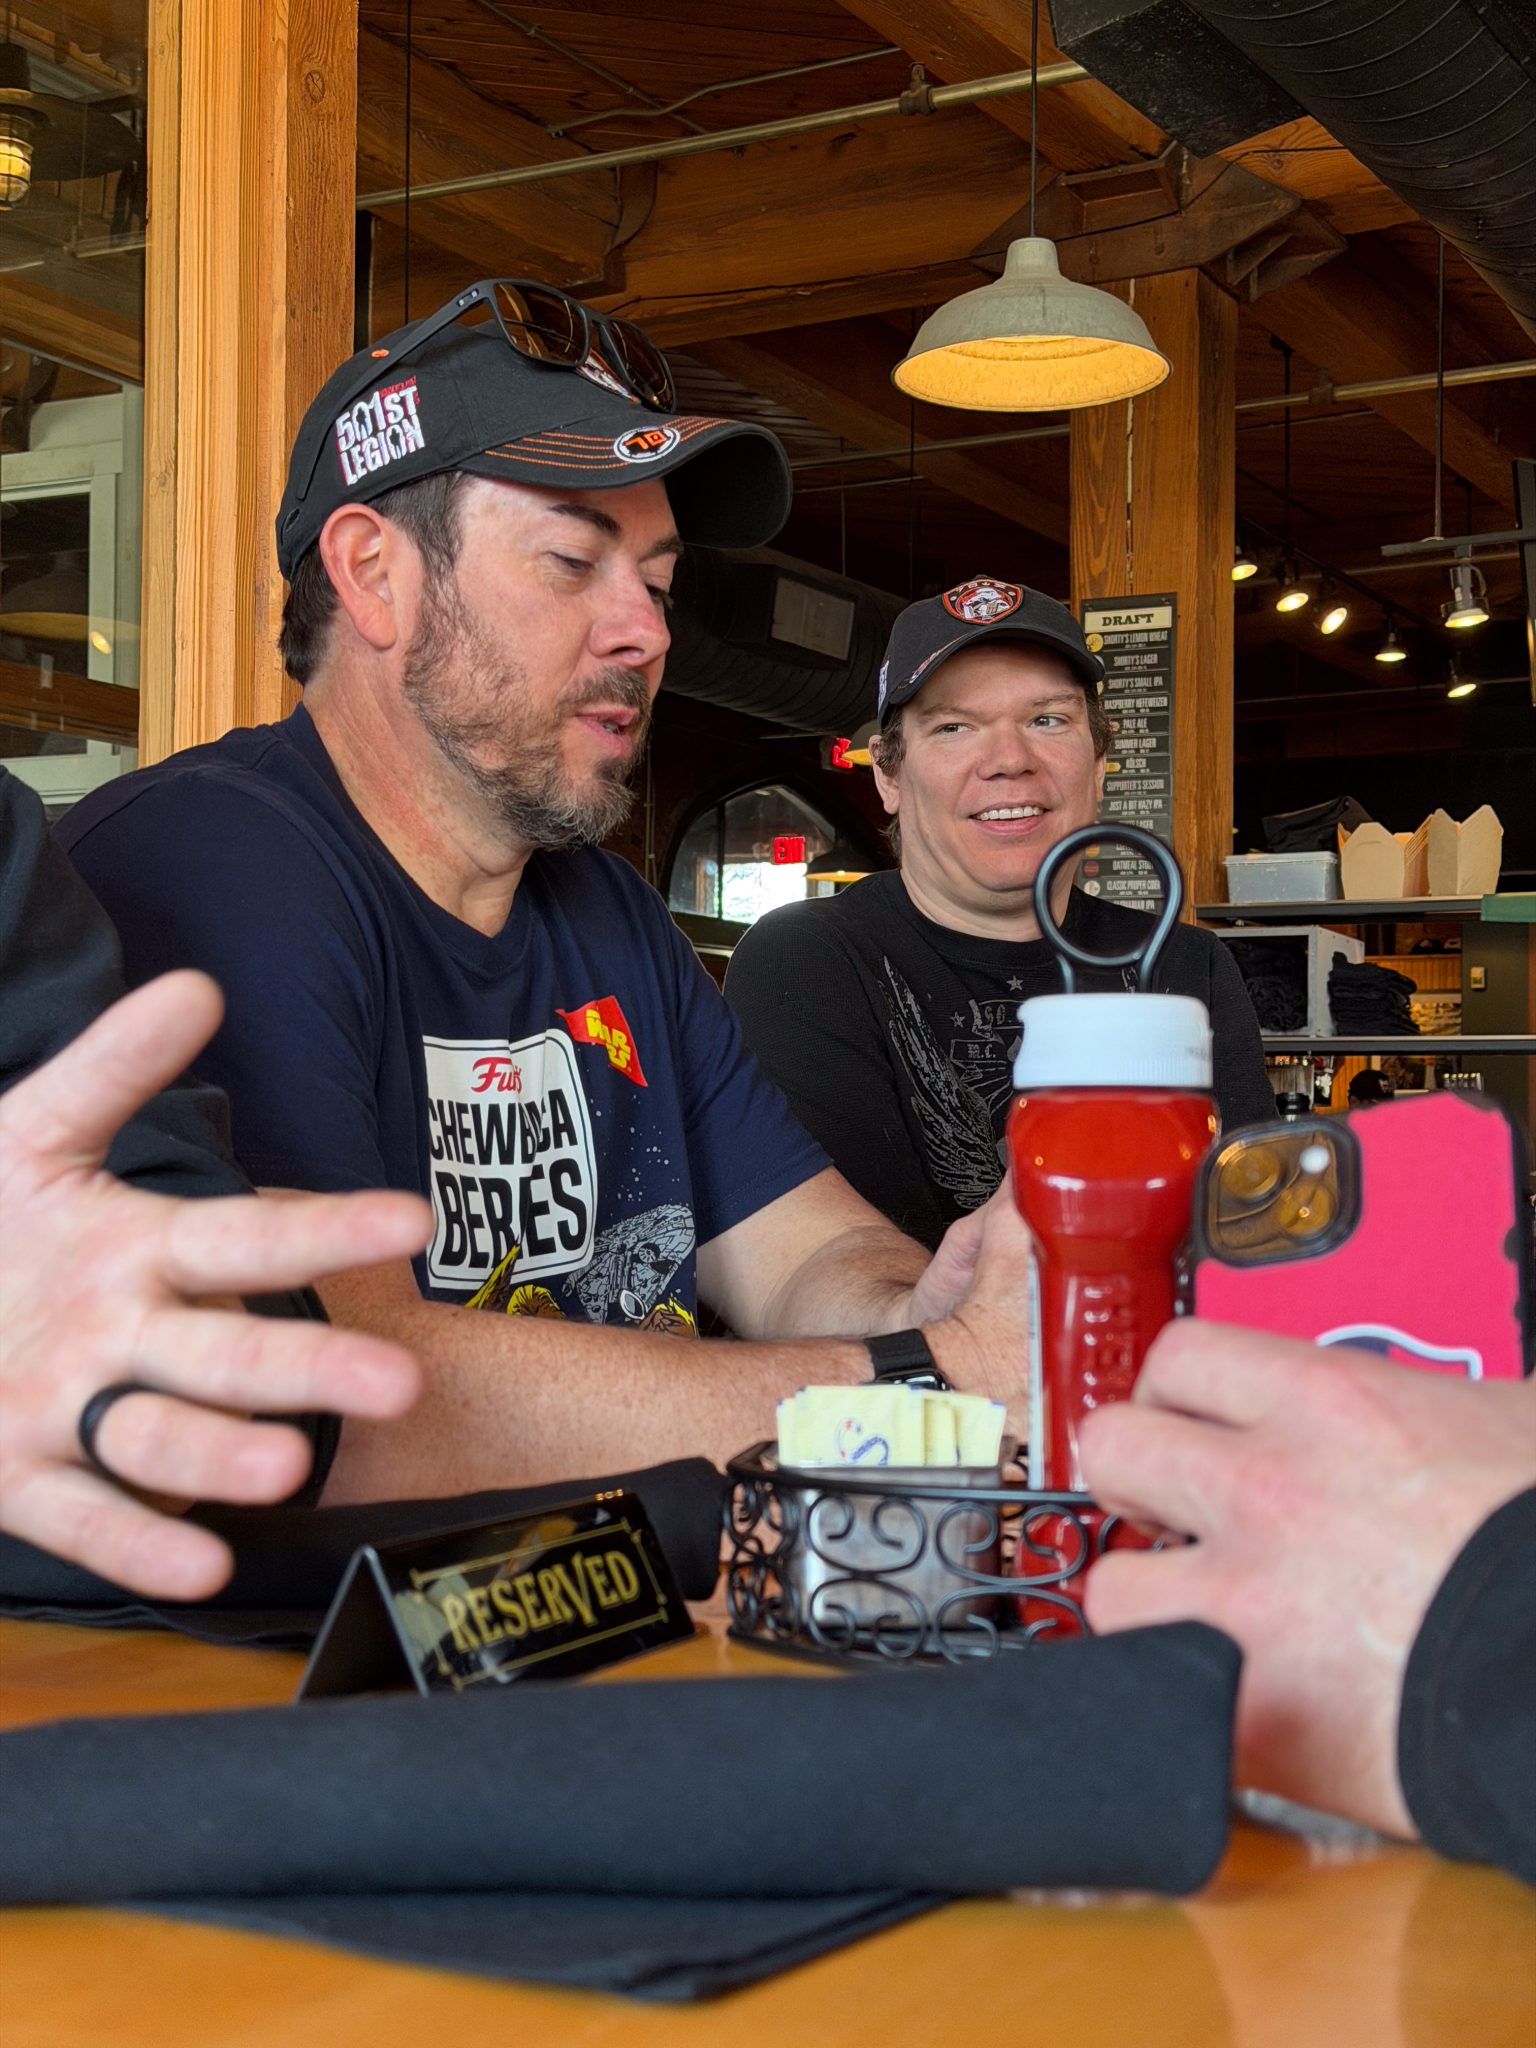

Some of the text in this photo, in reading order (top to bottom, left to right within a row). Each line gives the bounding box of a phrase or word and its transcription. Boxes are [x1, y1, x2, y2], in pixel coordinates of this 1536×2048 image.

[335, 386, 418, 452] 501ST
[340, 414, 426, 486] LEGION
[1101, 613, 1154, 627] DRAFT
[1113, 653, 1158, 667] SHORTY'S LAGER
[1107, 675, 1164, 690] SHORTY'S SMALL IPA
[1104, 699, 1135, 710] RASPBERRY
[1123, 717, 1148, 729] PALE ALE
[1114, 737, 1157, 750] SUMMER LAGER
[1142, 779, 1164, 790] SESSION
[1109, 801, 1122, 811] JUST
[1122, 801, 1128, 810] A
[1137, 799, 1153, 810] HAZY
[1153, 799, 1163, 809] IPA
[774, 836, 805, 863] EXIT
[1112, 860, 1137, 871] OATMEAL
[1106, 881, 1127, 891] CLASSIC
[441, 1551, 640, 1655] RESERVED
